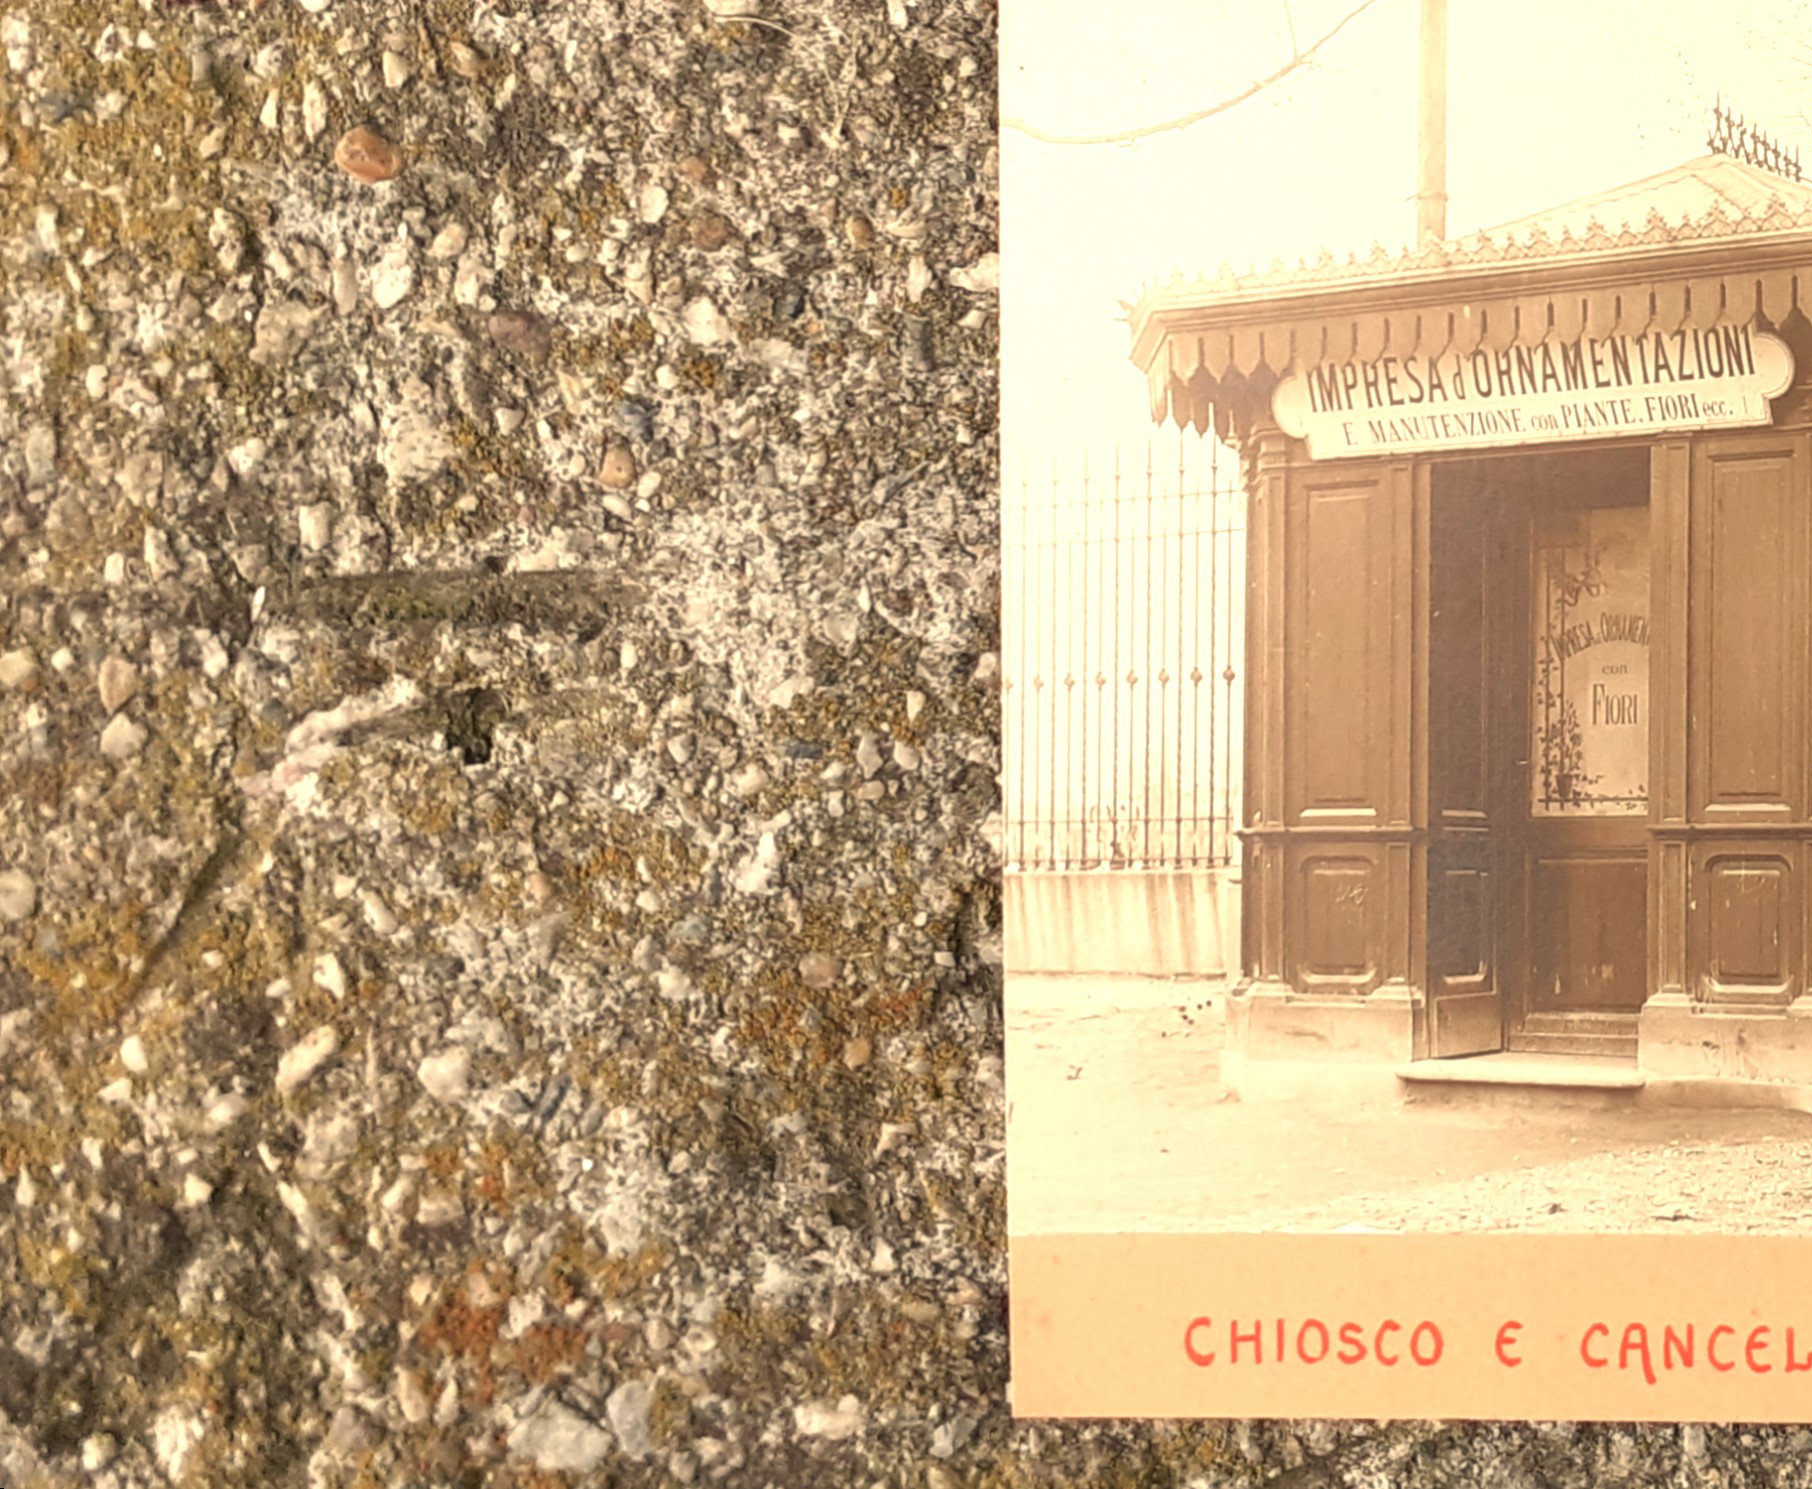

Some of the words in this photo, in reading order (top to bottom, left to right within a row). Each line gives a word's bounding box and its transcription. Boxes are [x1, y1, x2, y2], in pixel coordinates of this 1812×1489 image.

[1306, 355, 1449, 413] IMPRESA
[1343, 421, 1360, 446] E
[1367, 407, 1527, 445] MANUTENZIONE
[1530, 413, 1559, 432] con
[1645, 392, 1700, 424] FIORI
[1601, 664, 1628, 675] con
[1593, 683, 1638, 725] FIORI
[1184, 1316, 1444, 1367] CHIOSCO
[1494, 1319, 1524, 1367] E
